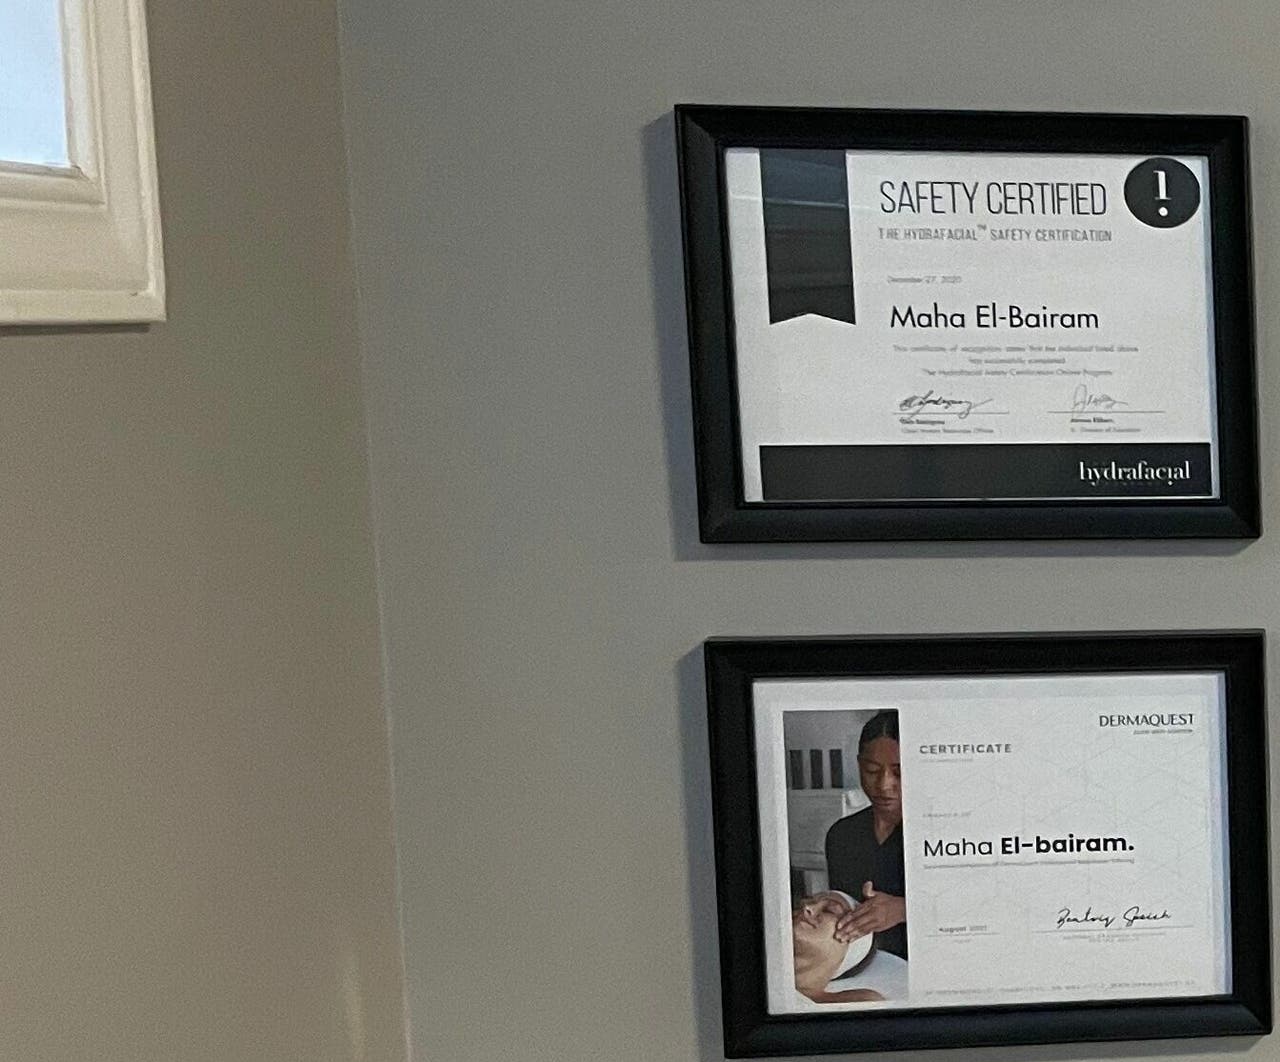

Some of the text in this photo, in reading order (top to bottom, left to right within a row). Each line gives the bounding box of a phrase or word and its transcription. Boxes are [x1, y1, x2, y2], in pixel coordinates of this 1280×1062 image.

[880, 181, 1107, 215] SAFETY CERTIFIED
[879, 227, 900, 240] THE
[991, 228, 1031, 242] SAFETY
[1036, 229, 1112, 243] CERTIFICATION
[890, 302, 1099, 329] Maha El-Bairam
[1079, 460, 1191, 486] hydrafacial
[1098, 713, 1194, 727] DERMAQUEST
[919, 743, 1012, 755] CERTIFICATE
[923, 834, 1135, 857] Maha El-bairam.
